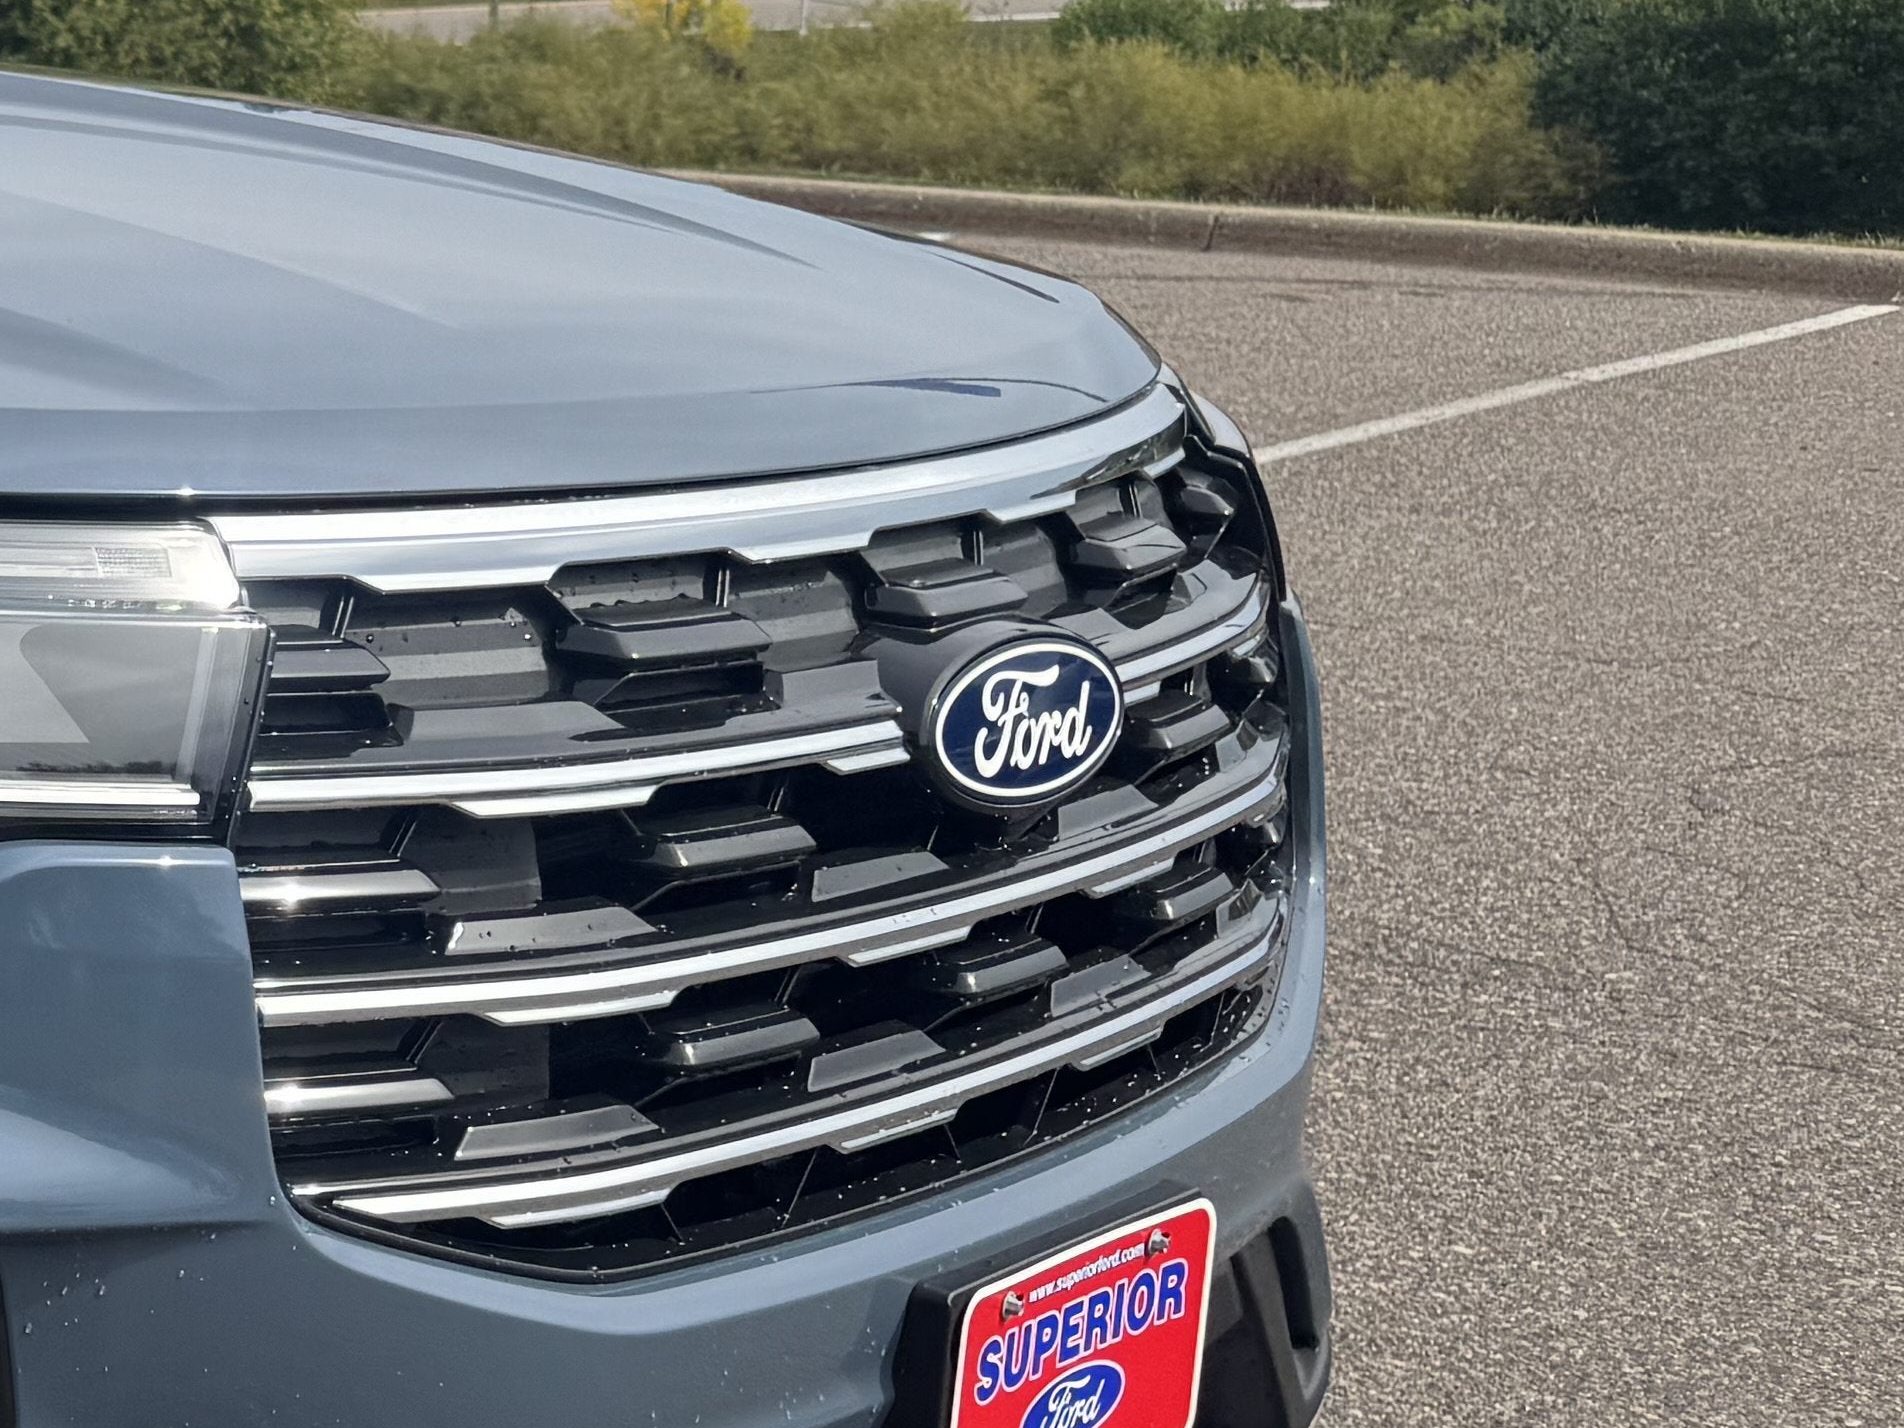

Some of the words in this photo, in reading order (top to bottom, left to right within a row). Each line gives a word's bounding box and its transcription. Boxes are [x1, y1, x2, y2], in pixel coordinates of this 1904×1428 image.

[973, 664, 1093, 779] Ford
[1028, 1242, 1145, 1303] www.superiorford.com
[974, 1258, 1189, 1406] SUPERIOR
